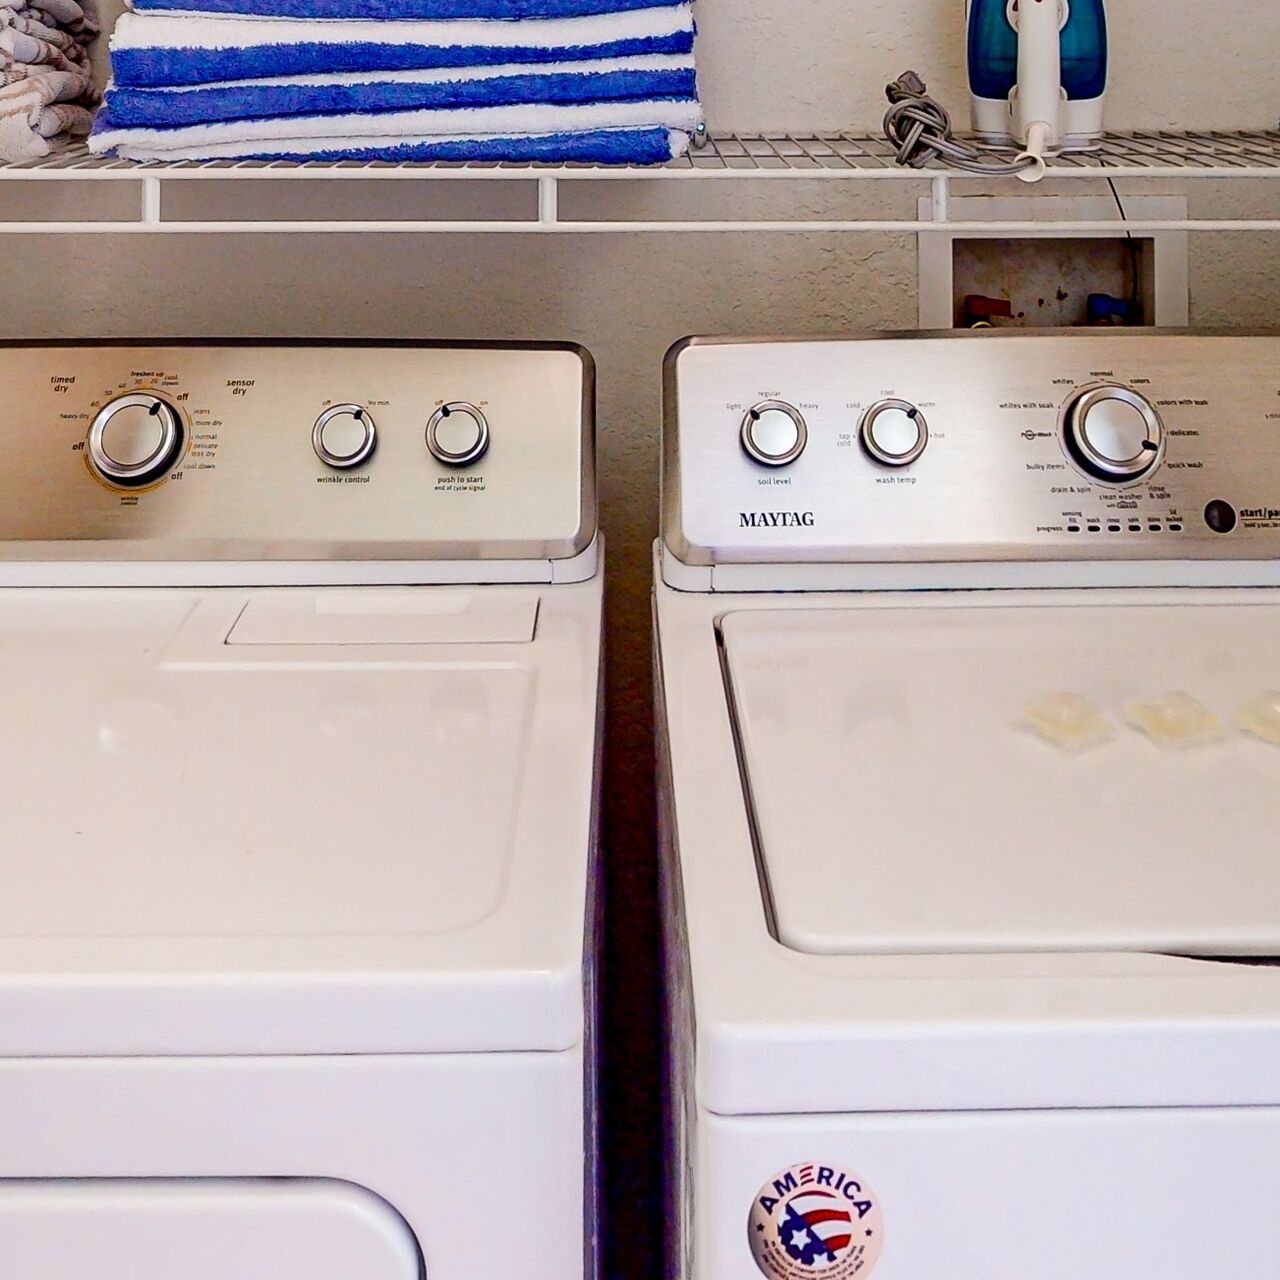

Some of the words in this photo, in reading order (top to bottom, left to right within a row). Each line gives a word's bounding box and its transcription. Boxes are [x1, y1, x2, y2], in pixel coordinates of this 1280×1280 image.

[50, 375, 75, 384] timed
[225, 379, 255, 387] sensor
[54, 384, 69, 393] dry
[232, 387, 247, 396] dry
[176, 392, 189, 401] off
[72, 442, 85, 451] off
[1026, 463, 1045, 471] bulky
[171, 471, 183, 480] off
[757, 477, 772, 485] soil
[773, 477, 792, 485] level
[897, 477, 917, 485] temp
[739, 511, 814, 527] MAYTAG
[759, 1164, 873, 1220] AMERICA
